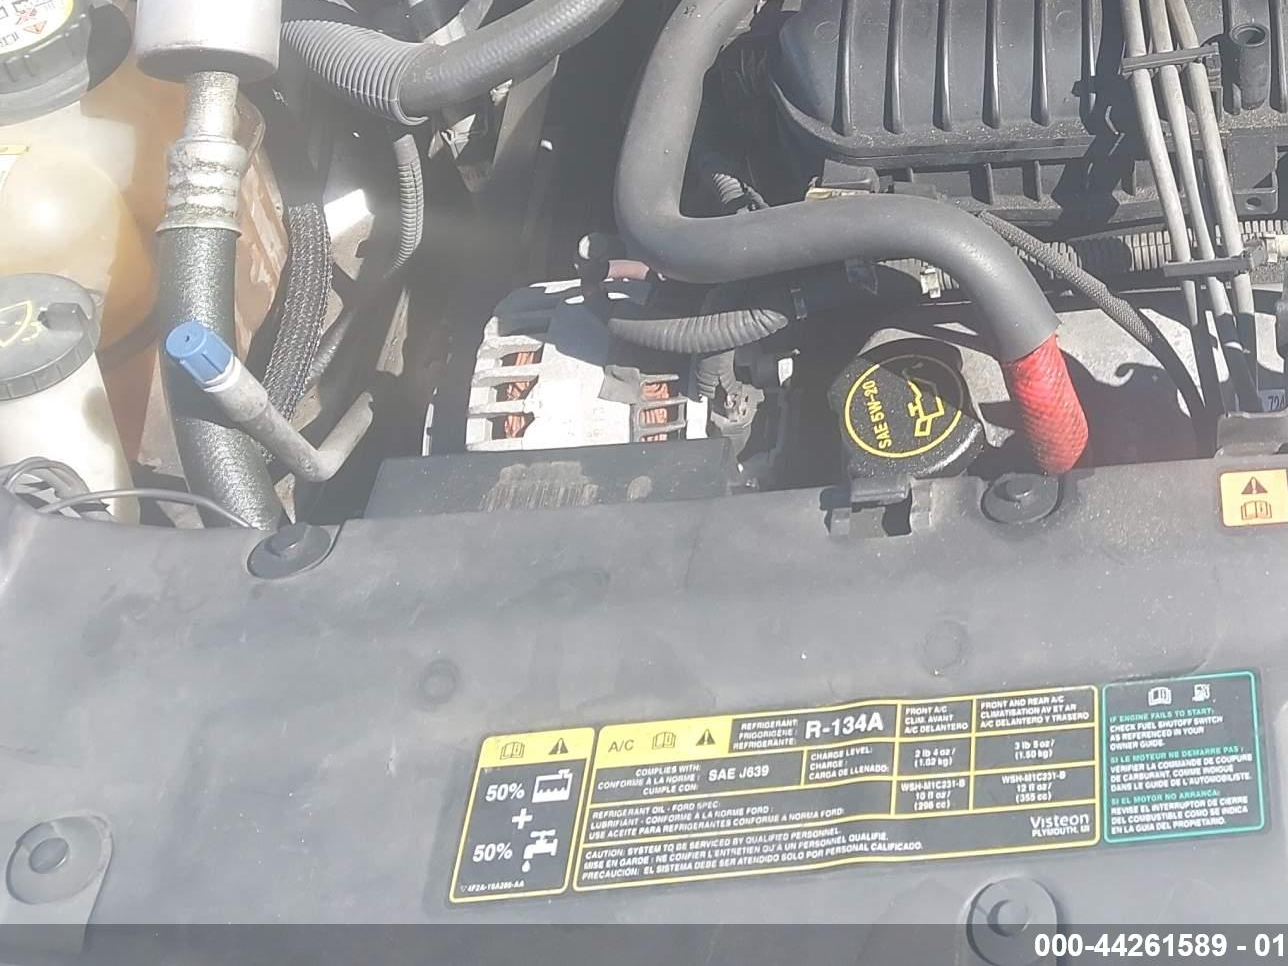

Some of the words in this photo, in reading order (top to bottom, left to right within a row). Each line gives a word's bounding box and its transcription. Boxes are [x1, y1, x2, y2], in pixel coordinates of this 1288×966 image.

[862, 380, 885, 422] 5W-20
[873, 422, 893, 449] SAE
[804, 712, 884, 738] R-134A
[608, 739, 635, 753] A/C
[810, 749, 844, 761] CHARGE
[844, 745, 872, 756] LEVEL:
[634, 765, 677, 777] COMPLIES
[678, 763, 701, 772] WITH:
[707, 769, 736, 781] SAE
[737, 764, 769, 779] J639
[485, 782, 525, 802] 50%
[642, 784, 676, 795] CUMPLE
[677, 782, 699, 792] CON:
[1030, 813, 1089, 828] Visteon
[472, 842, 513, 862] 50%
